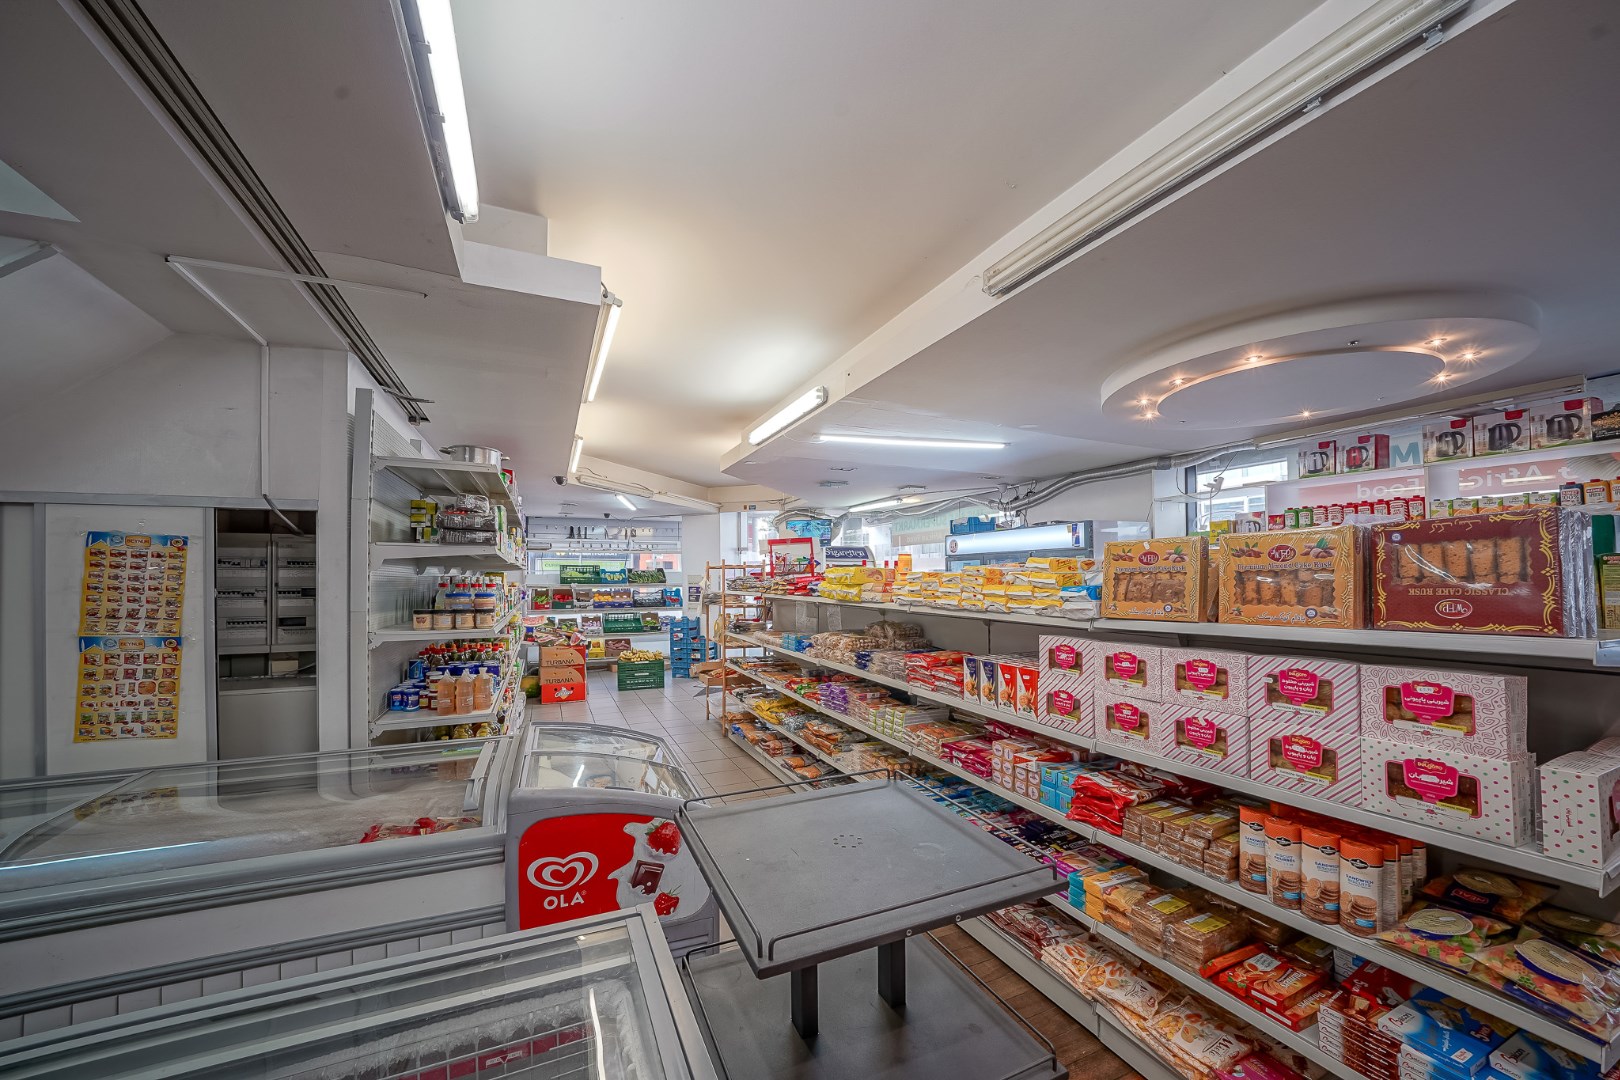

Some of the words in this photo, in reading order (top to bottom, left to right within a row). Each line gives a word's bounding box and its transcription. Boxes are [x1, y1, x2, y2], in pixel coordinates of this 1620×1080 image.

[1408, 588, 1433, 596] RUSK
[1435, 588, 1462, 597] CAKE
[1465, 588, 1509, 597] CLASSIC
[545, 658, 575, 666] TURBANA
[544, 677, 575, 685] TURBANA
[543, 892, 585, 910] OLA
